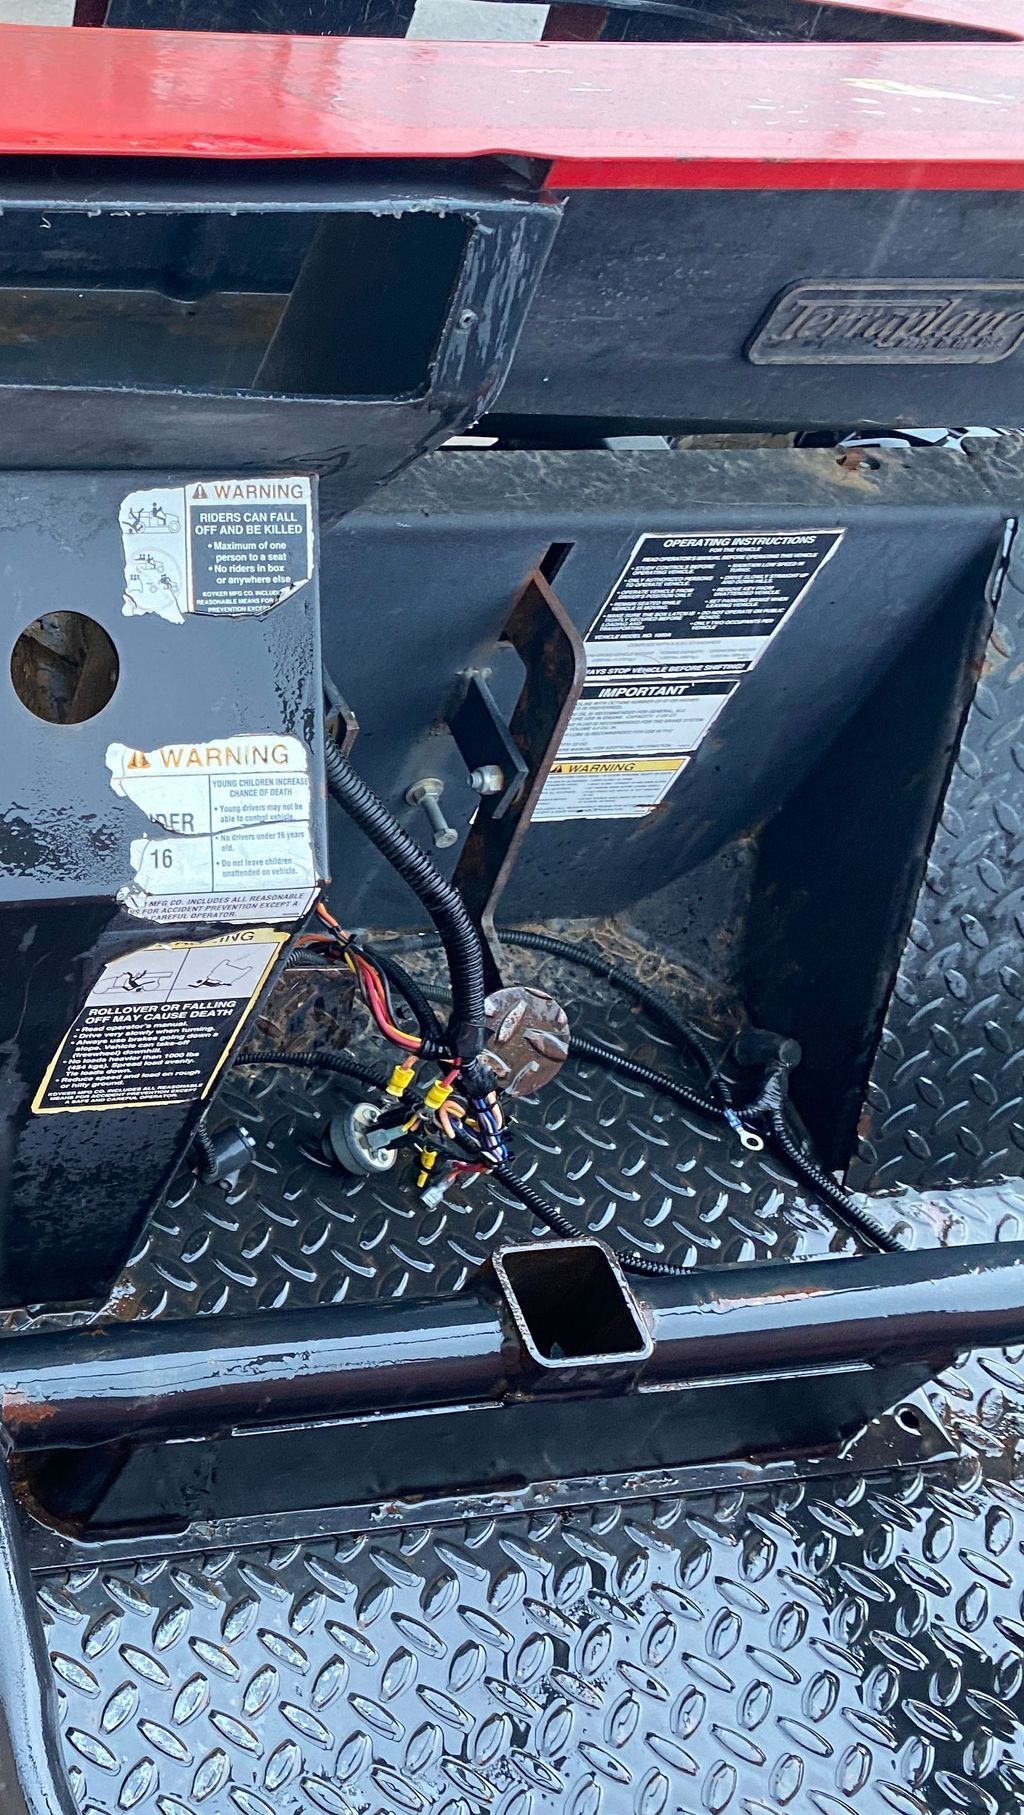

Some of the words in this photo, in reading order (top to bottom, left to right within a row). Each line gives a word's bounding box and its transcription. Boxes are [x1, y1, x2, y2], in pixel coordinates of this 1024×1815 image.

[214, 484, 304, 500] WARNING
[199, 512, 241, 523] RIDERS
[243, 512, 267, 522] CAN
[270, 512, 297, 522] FALL
[195, 525, 217, 535] OFF
[219, 525, 243, 535] AND
[246, 525, 262, 534] BE
[264, 524, 303, 534] KILLED
[213, 542, 257, 550] Maximum
[258, 541, 268, 549] of
[269, 542, 287, 550] one
[663, 537, 731, 548] OPERATING
[731, 535, 817, 546] INSTRUCTIONS
[216, 554, 247, 563] person
[249, 553, 258, 561] to
[268, 552, 287, 561] seat
[214, 564, 228, 573] No
[229, 564, 255, 573] riders
[257, 564, 266, 572] in
[268, 564, 284, 572] box
[228, 575, 271, 586] anywhere
[272, 575, 291, 583] else
[238, 597, 260, 605] MEANS
[606, 666, 632, 675] STOP
[632, 665, 668, 674] VEHICLE
[668, 664, 703, 672] BEFORE
[703, 663, 745, 671] SHIFTING!
[598, 685, 689, 698] IMPORTANT
[160, 743, 290, 768] WARNING
[568, 763, 636, 773] WARNING
[212, 779, 237, 788] YOUNG
[239, 778, 274, 787] CHILDREN
[276, 777, 309, 786] INCREASE
[229, 789, 258, 797] CHANCE
[259, 788, 269, 796] OF
[270, 788, 293, 796] DEATH
[219, 805, 241, 813] Young
[242, 804, 266, 812] drivers
[267, 803, 281, 812] may
[294, 802, 303, 810] be
[220, 815, 235, 823] able
[245, 814, 268, 822] control
[231, 833, 255, 841] drivers
[256, 832, 276, 840] under
[277, 831, 286, 839] 16
[286, 831, 305, 839] years
[221, 844, 234, 852] old.
[150, 848, 173, 869] 16
[221, 859, 232, 867] Do
[245, 858, 263, 866] leave
[265, 857, 292, 865] children
[222, 868, 260, 877] unattended
[271, 867, 298, 875] vehicle.
[148, 899, 168, 907] MFG
[187, 896, 230, 905] INCLUDES
[248, 892, 305, 902] REASONABLE
[142, 907, 159, 915] FOR
[160, 905, 204, 914] ACCIDENT
[204, 903, 259, 911] PREVENTION
[259, 901, 291, 909] EXCEPT
[190, 911, 237, 919] OPERATOR.
[88, 1005, 159, 1016] ROLLOVER
[160, 1003, 181, 1012] OR
[182, 1000, 237, 1011] FALLING
[84, 1016, 112, 1025] OFF
[112, 1014, 143, 1023] MAY
[143, 1011, 188, 1021] CAUSE
[189, 1008, 234, 1018] DEATH
[81, 1025, 105, 1033] Read
[105, 1023, 152, 1032] operator's
[153, 1021, 188, 1029] manual.
[159, 1033, 185, 1041] going
[156, 1039, 191, 1047] take-off
[72, 1050, 121, 1059] (freewheel)
[111, 1061, 143, 1069] Spread
[91, 1080, 125, 1088] ground.
